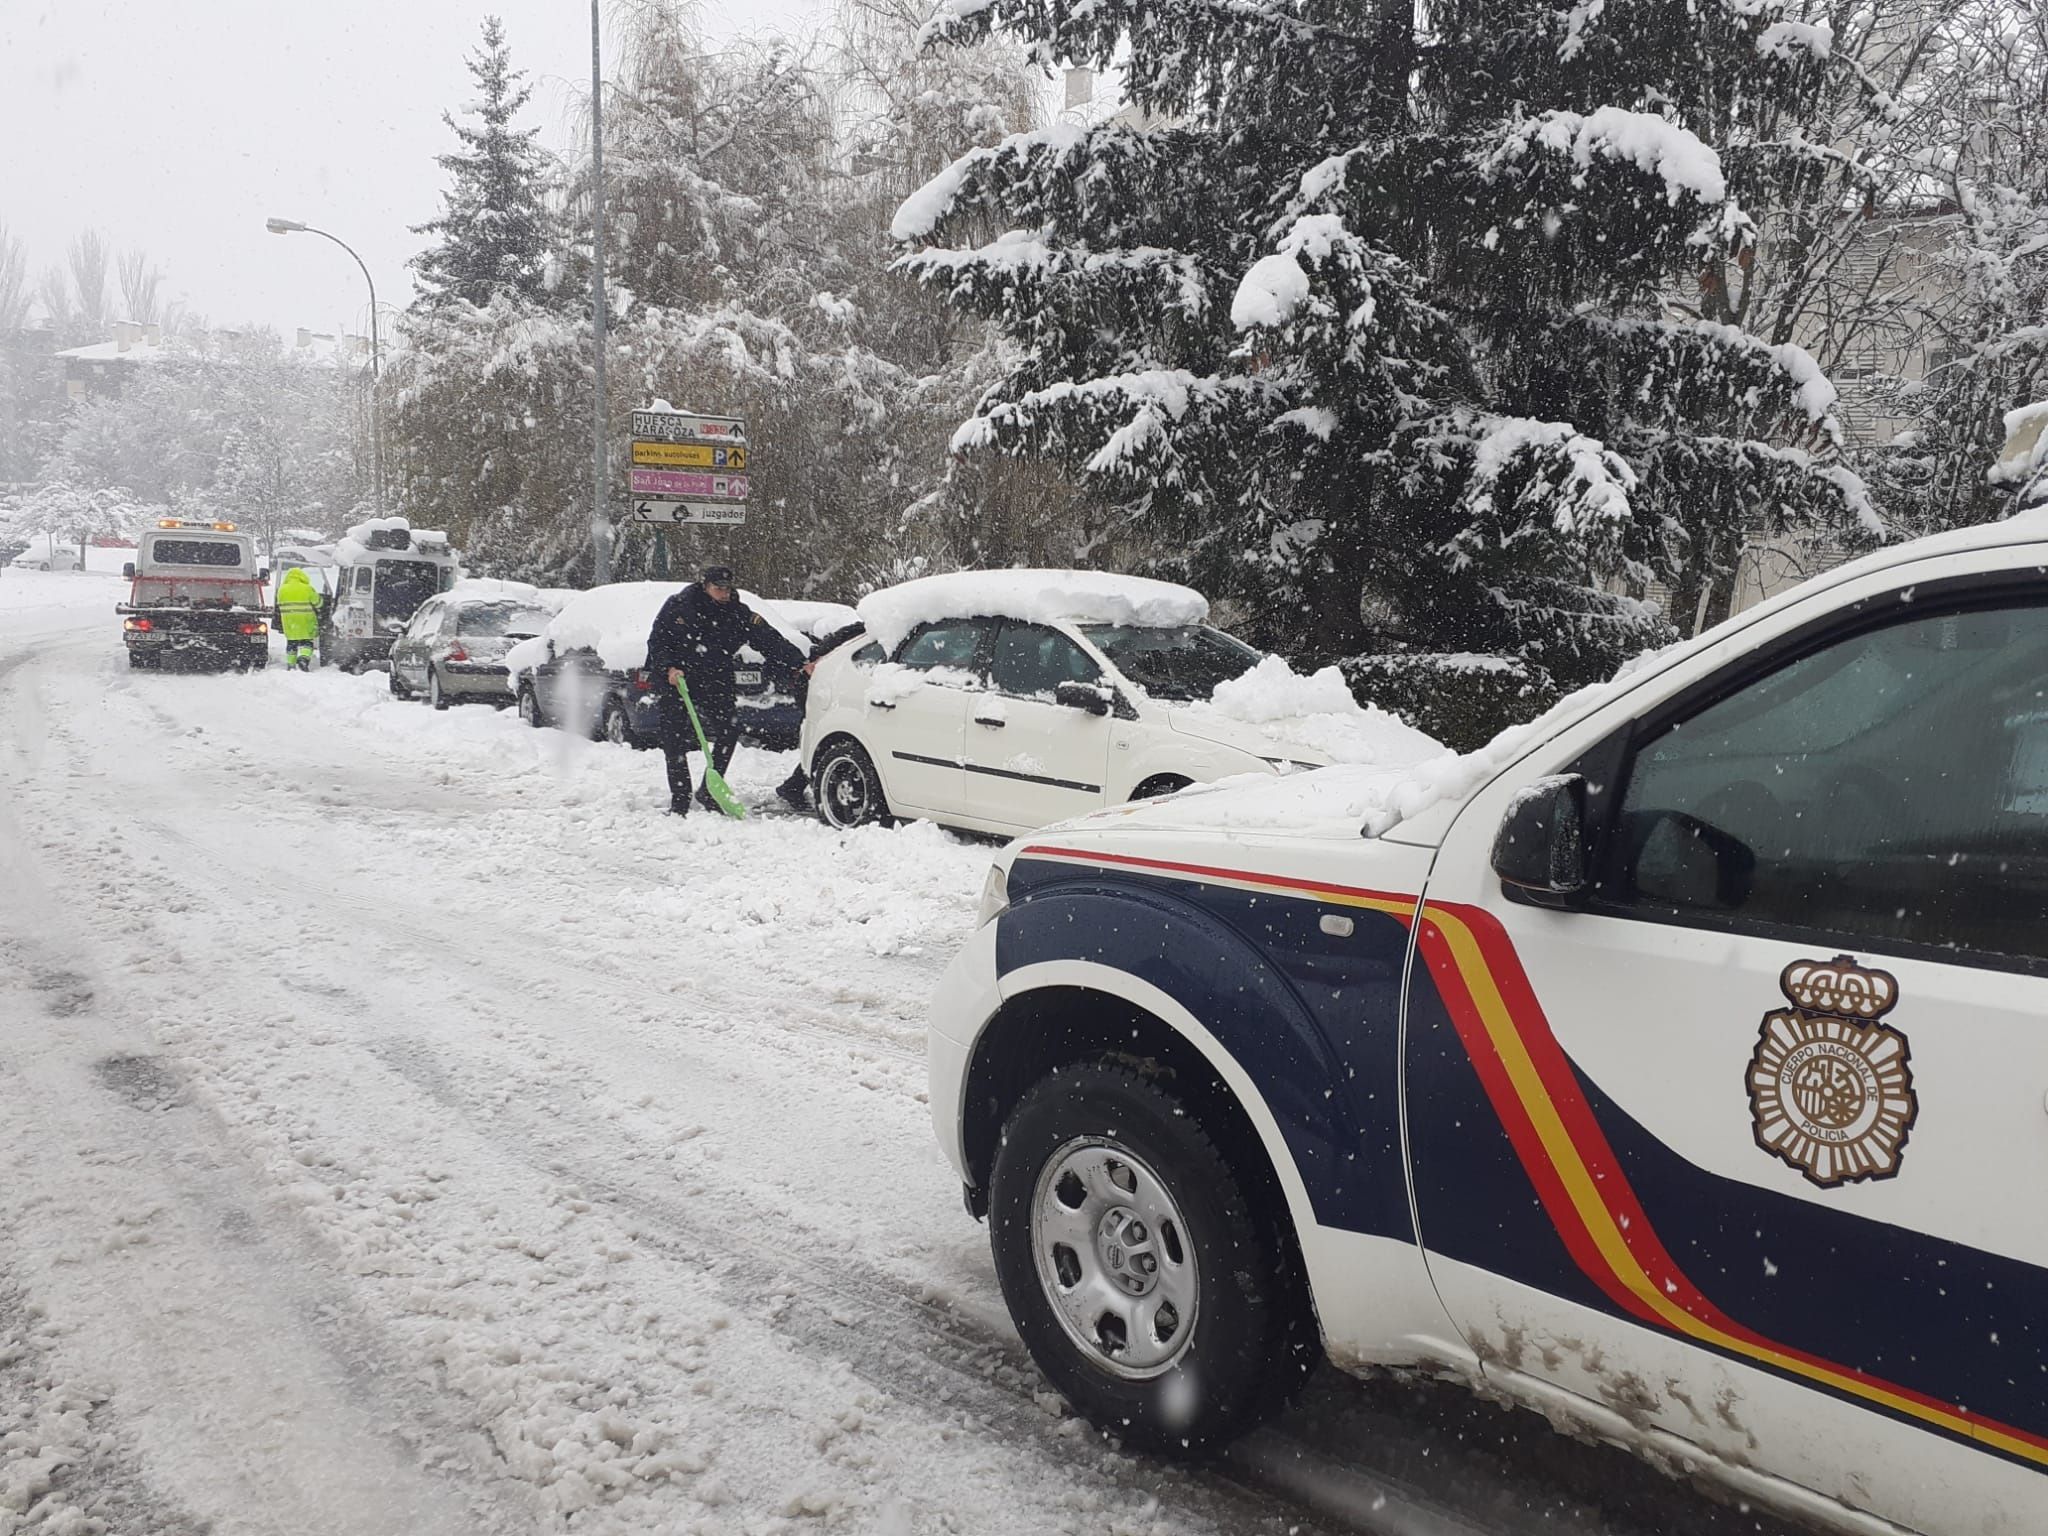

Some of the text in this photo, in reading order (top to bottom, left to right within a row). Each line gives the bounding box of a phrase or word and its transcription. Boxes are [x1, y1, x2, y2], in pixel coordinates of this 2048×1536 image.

[634, 415, 683, 427] HUESCA
[634, 424, 695, 437] ZARAGOZA
[702, 508, 745, 520] juzgados
[1782, 1044, 1879, 1102] CUERPO NACIONAL DE
[1800, 1121, 1850, 1142] POLICIA
